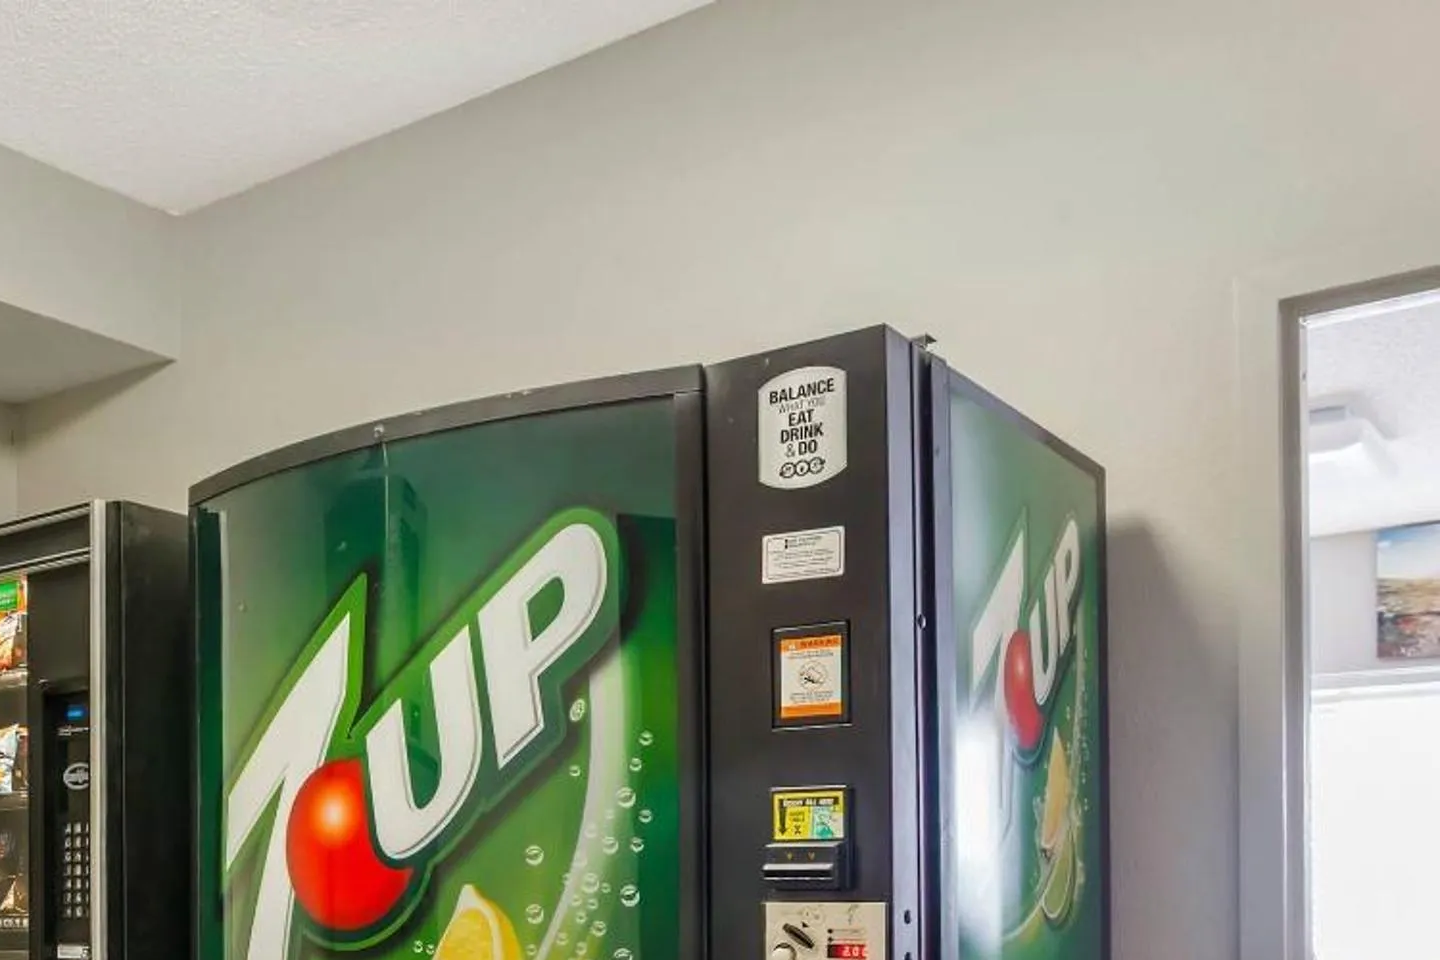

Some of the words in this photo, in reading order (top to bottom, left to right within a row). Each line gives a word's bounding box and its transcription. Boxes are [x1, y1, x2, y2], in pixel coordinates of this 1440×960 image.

[769, 378, 835, 405] BALANCE
[788, 409, 814, 427] EAT
[780, 422, 824, 444] DRINK
[798, 439, 818, 456] DO
